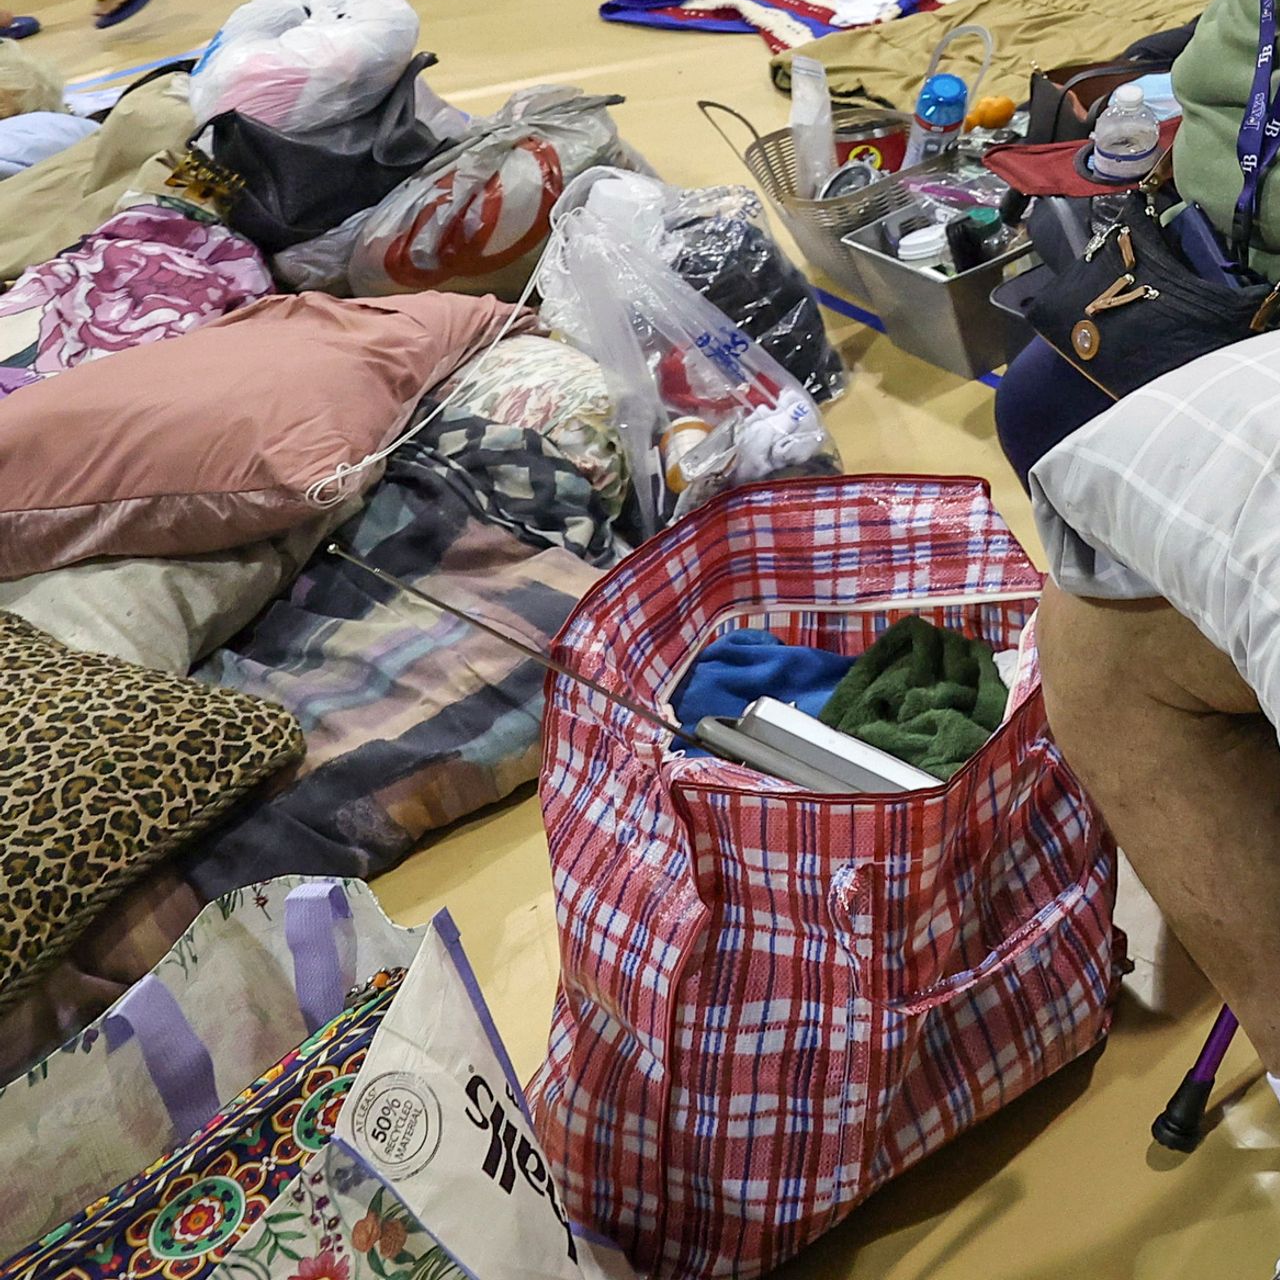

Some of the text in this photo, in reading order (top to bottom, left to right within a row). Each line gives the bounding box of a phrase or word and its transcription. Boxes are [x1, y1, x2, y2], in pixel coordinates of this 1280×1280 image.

[1257, 44, 1273, 68] TB
[371, 1096, 402, 1144] 50%
[385, 1099, 415, 1157] RECYCLED
[395, 1107, 423, 1161] MATERIAL
